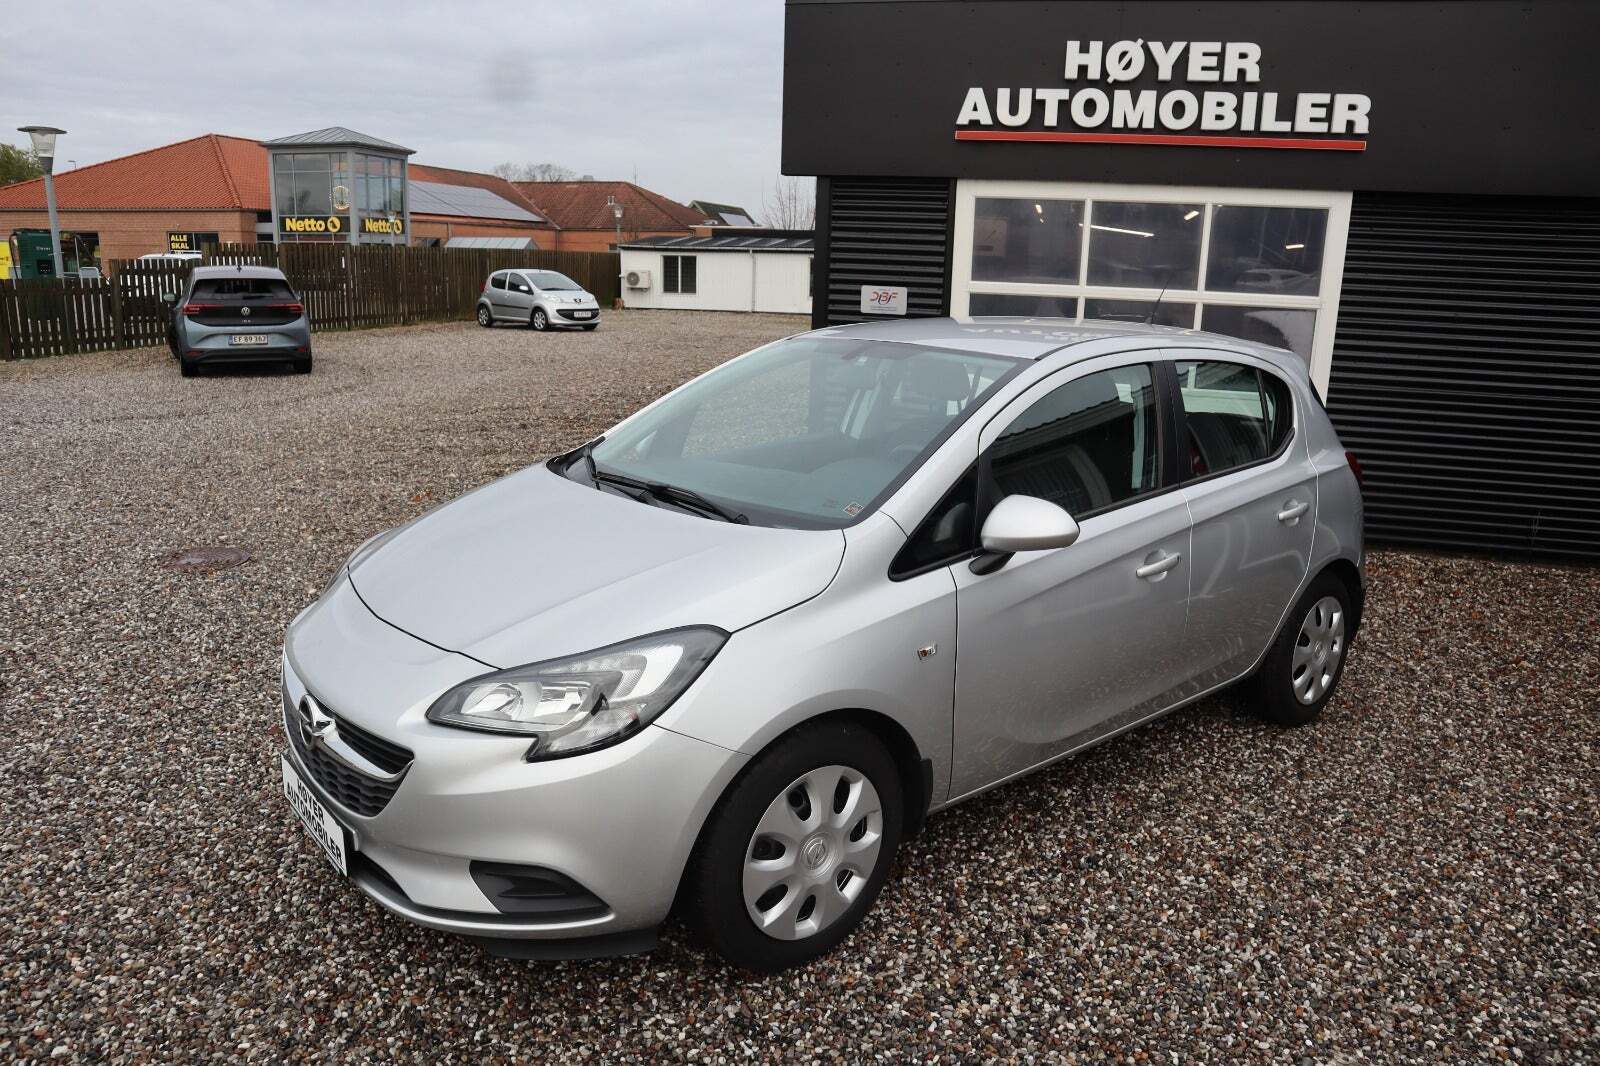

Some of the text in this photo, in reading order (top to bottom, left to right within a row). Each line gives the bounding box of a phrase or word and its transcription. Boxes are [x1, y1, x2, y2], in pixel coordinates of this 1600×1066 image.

[1064, 38, 1261, 83] HØYER
[956, 87, 1371, 134] AUTOMOBILER
[285, 218, 325, 232] Netto
[365, 218, 391, 233] Netto
[171, 234, 188, 242] ALLE
[171, 242, 190, 250] SKAL
[287, 782, 342, 865] AUTOMOBILER
